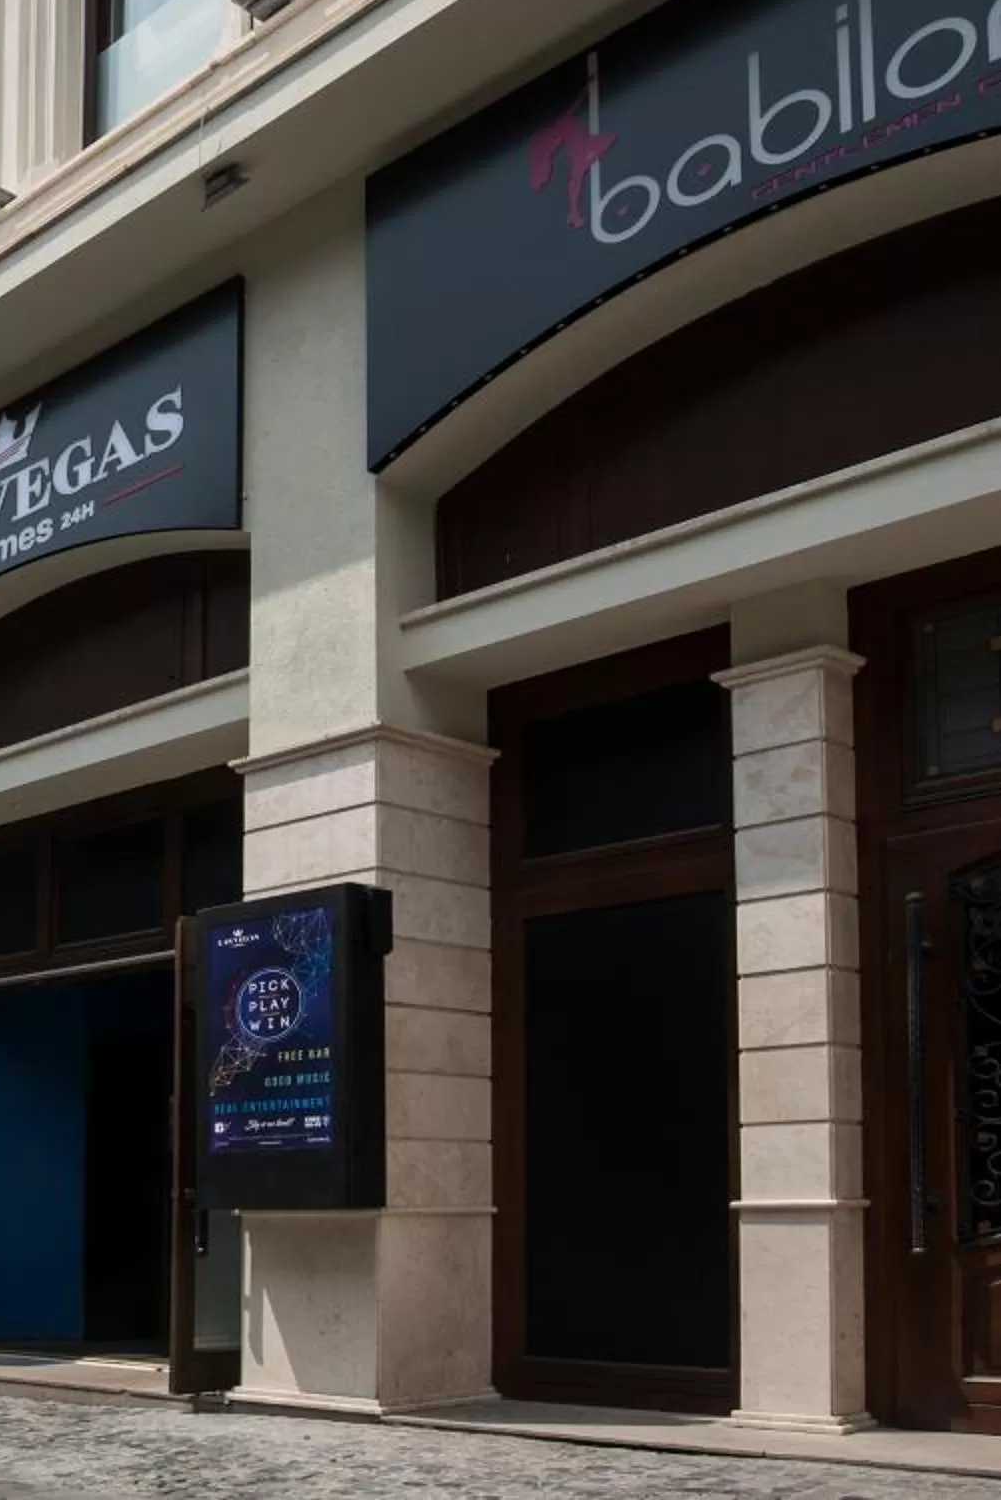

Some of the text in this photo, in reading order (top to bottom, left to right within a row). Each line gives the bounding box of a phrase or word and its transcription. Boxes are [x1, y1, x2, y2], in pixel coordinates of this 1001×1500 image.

[59, 500, 95, 531] 24H
[248, 980, 289, 994] PICK
[248, 997, 290, 1012] PLAY
[248, 1016, 290, 1031] WIN
